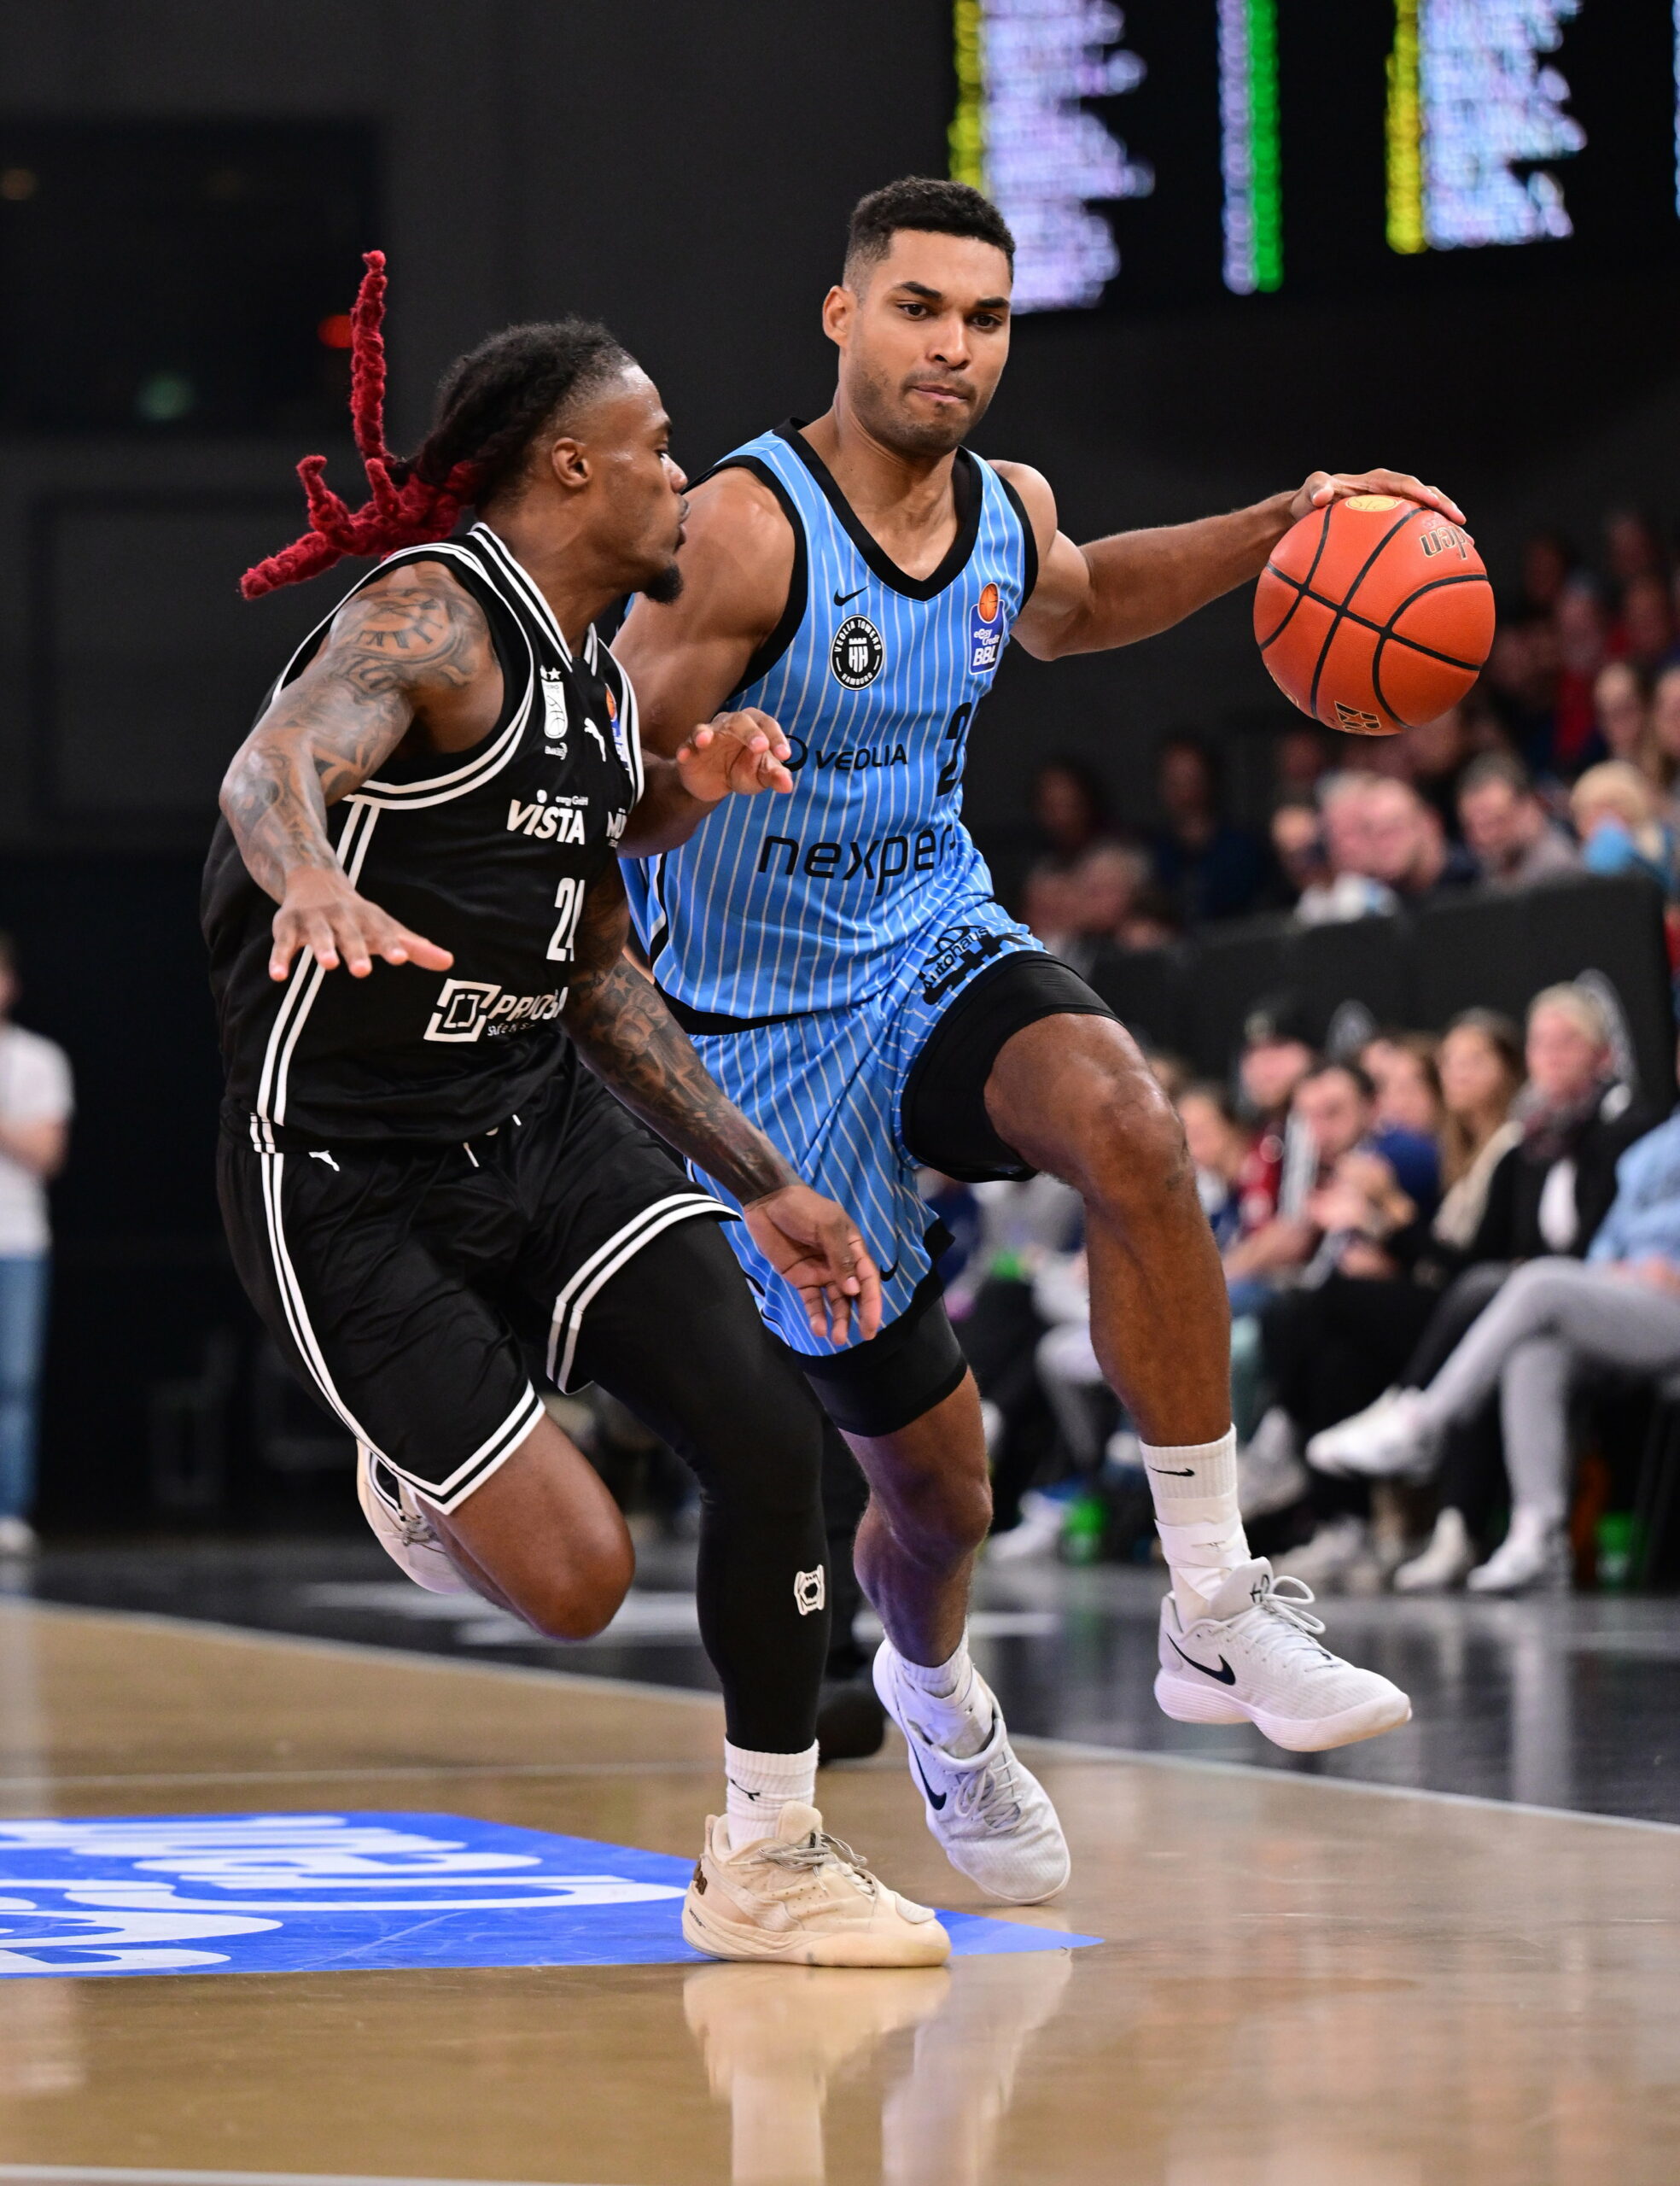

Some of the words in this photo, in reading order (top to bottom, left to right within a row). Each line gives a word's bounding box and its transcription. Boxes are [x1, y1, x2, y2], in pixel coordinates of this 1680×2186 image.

[972, 645, 996, 667] BBL
[814, 743, 907, 770] VEOLIA
[757, 823, 957, 897] nexper
